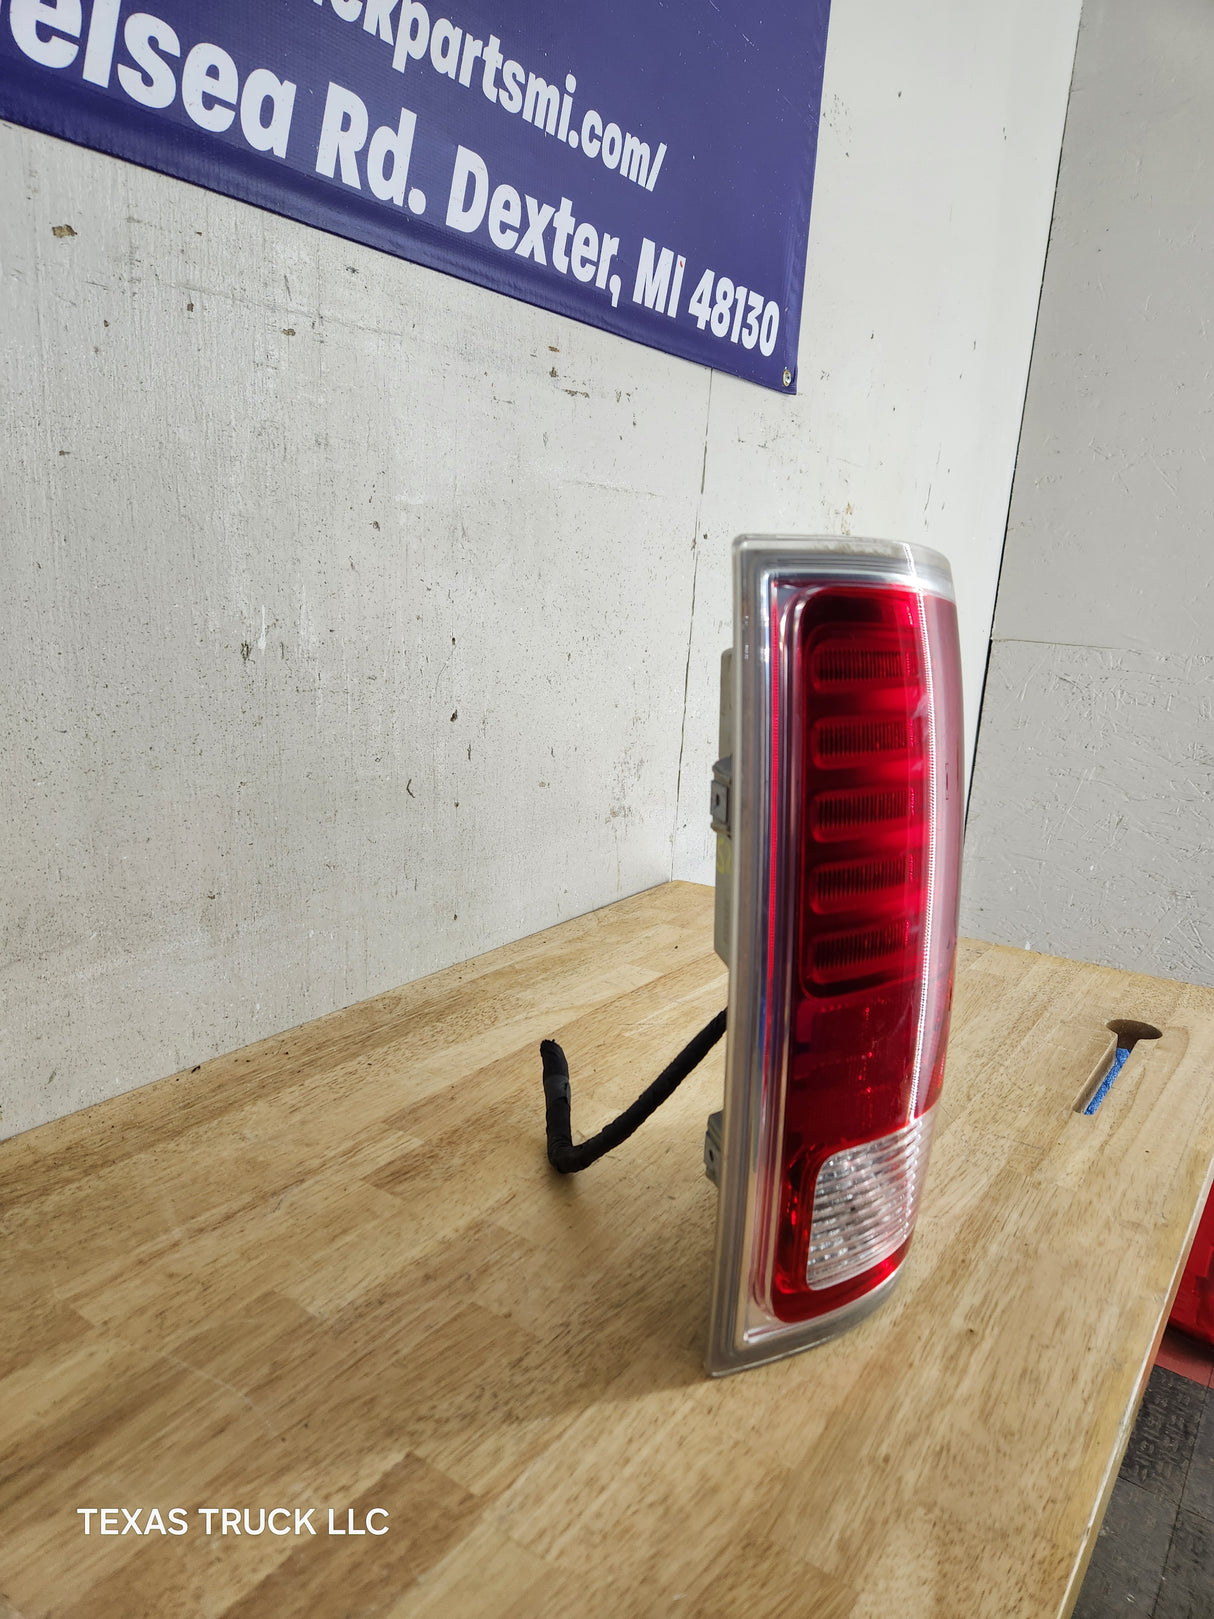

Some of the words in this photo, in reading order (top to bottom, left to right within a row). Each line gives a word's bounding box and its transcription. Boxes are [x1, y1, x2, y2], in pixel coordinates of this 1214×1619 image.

[312, 0, 668, 192] kpartsmi.com/
[316, 81, 427, 215] Rd.
[445, 144, 622, 308] Dexter,
[633, 237, 687, 319] MI
[687, 268, 780, 357] 48130
